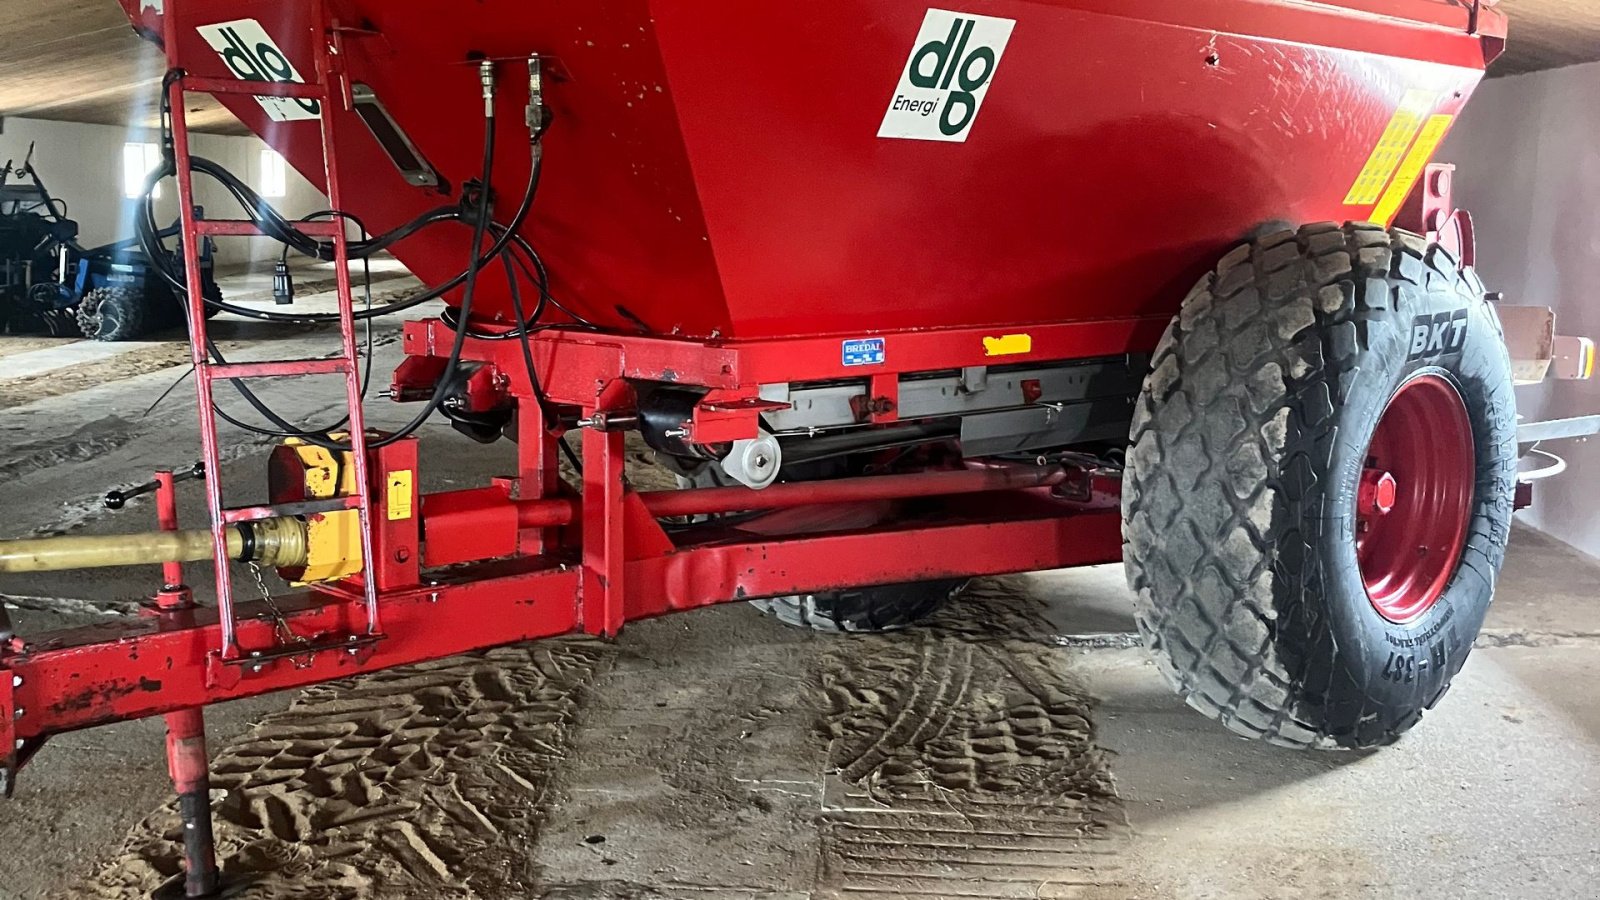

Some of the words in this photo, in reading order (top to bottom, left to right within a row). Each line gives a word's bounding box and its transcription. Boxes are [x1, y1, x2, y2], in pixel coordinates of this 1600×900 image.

[909, 18, 995, 136] dlg
[892, 95, 940, 117] Energi
[1410, 318, 1467, 355] BKT
